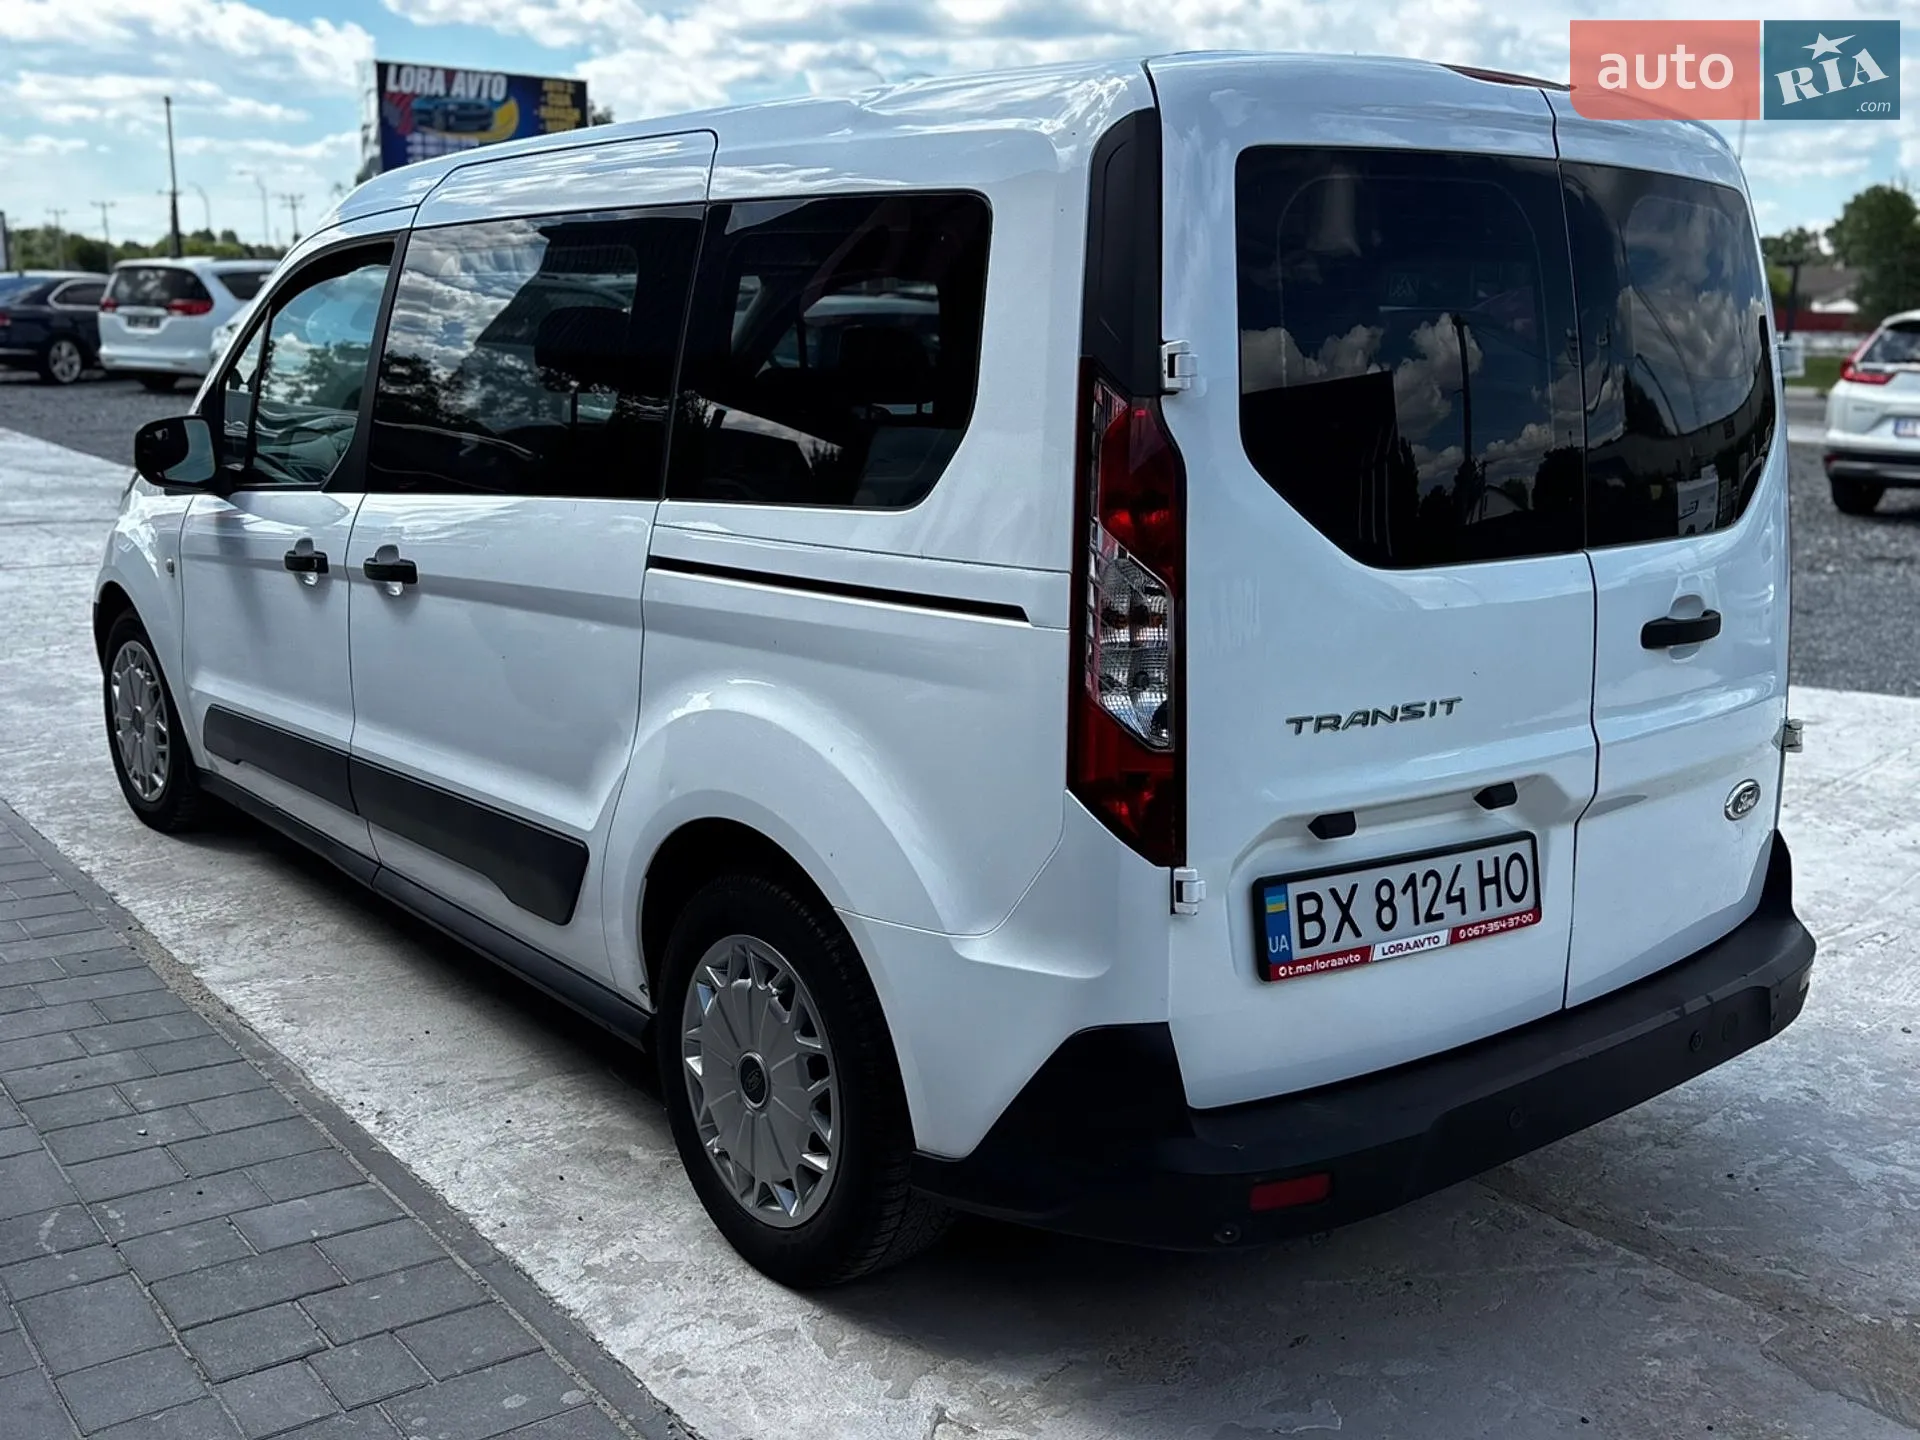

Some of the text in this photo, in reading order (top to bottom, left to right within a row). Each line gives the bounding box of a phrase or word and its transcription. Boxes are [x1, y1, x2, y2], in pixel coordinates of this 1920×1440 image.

[385, 65, 508, 101] LORA AVTO
[1285, 696, 1463, 736] TRANSIT
[1296, 852, 1529, 949] BX 8124 HO
[1466, 912, 1534, 938] 067-354-37-00
[1268, 934, 1290, 954] UA
[1381, 934, 1440, 957] LORAAVTO
[1288, 952, 1361, 976] t.me/loraavto
